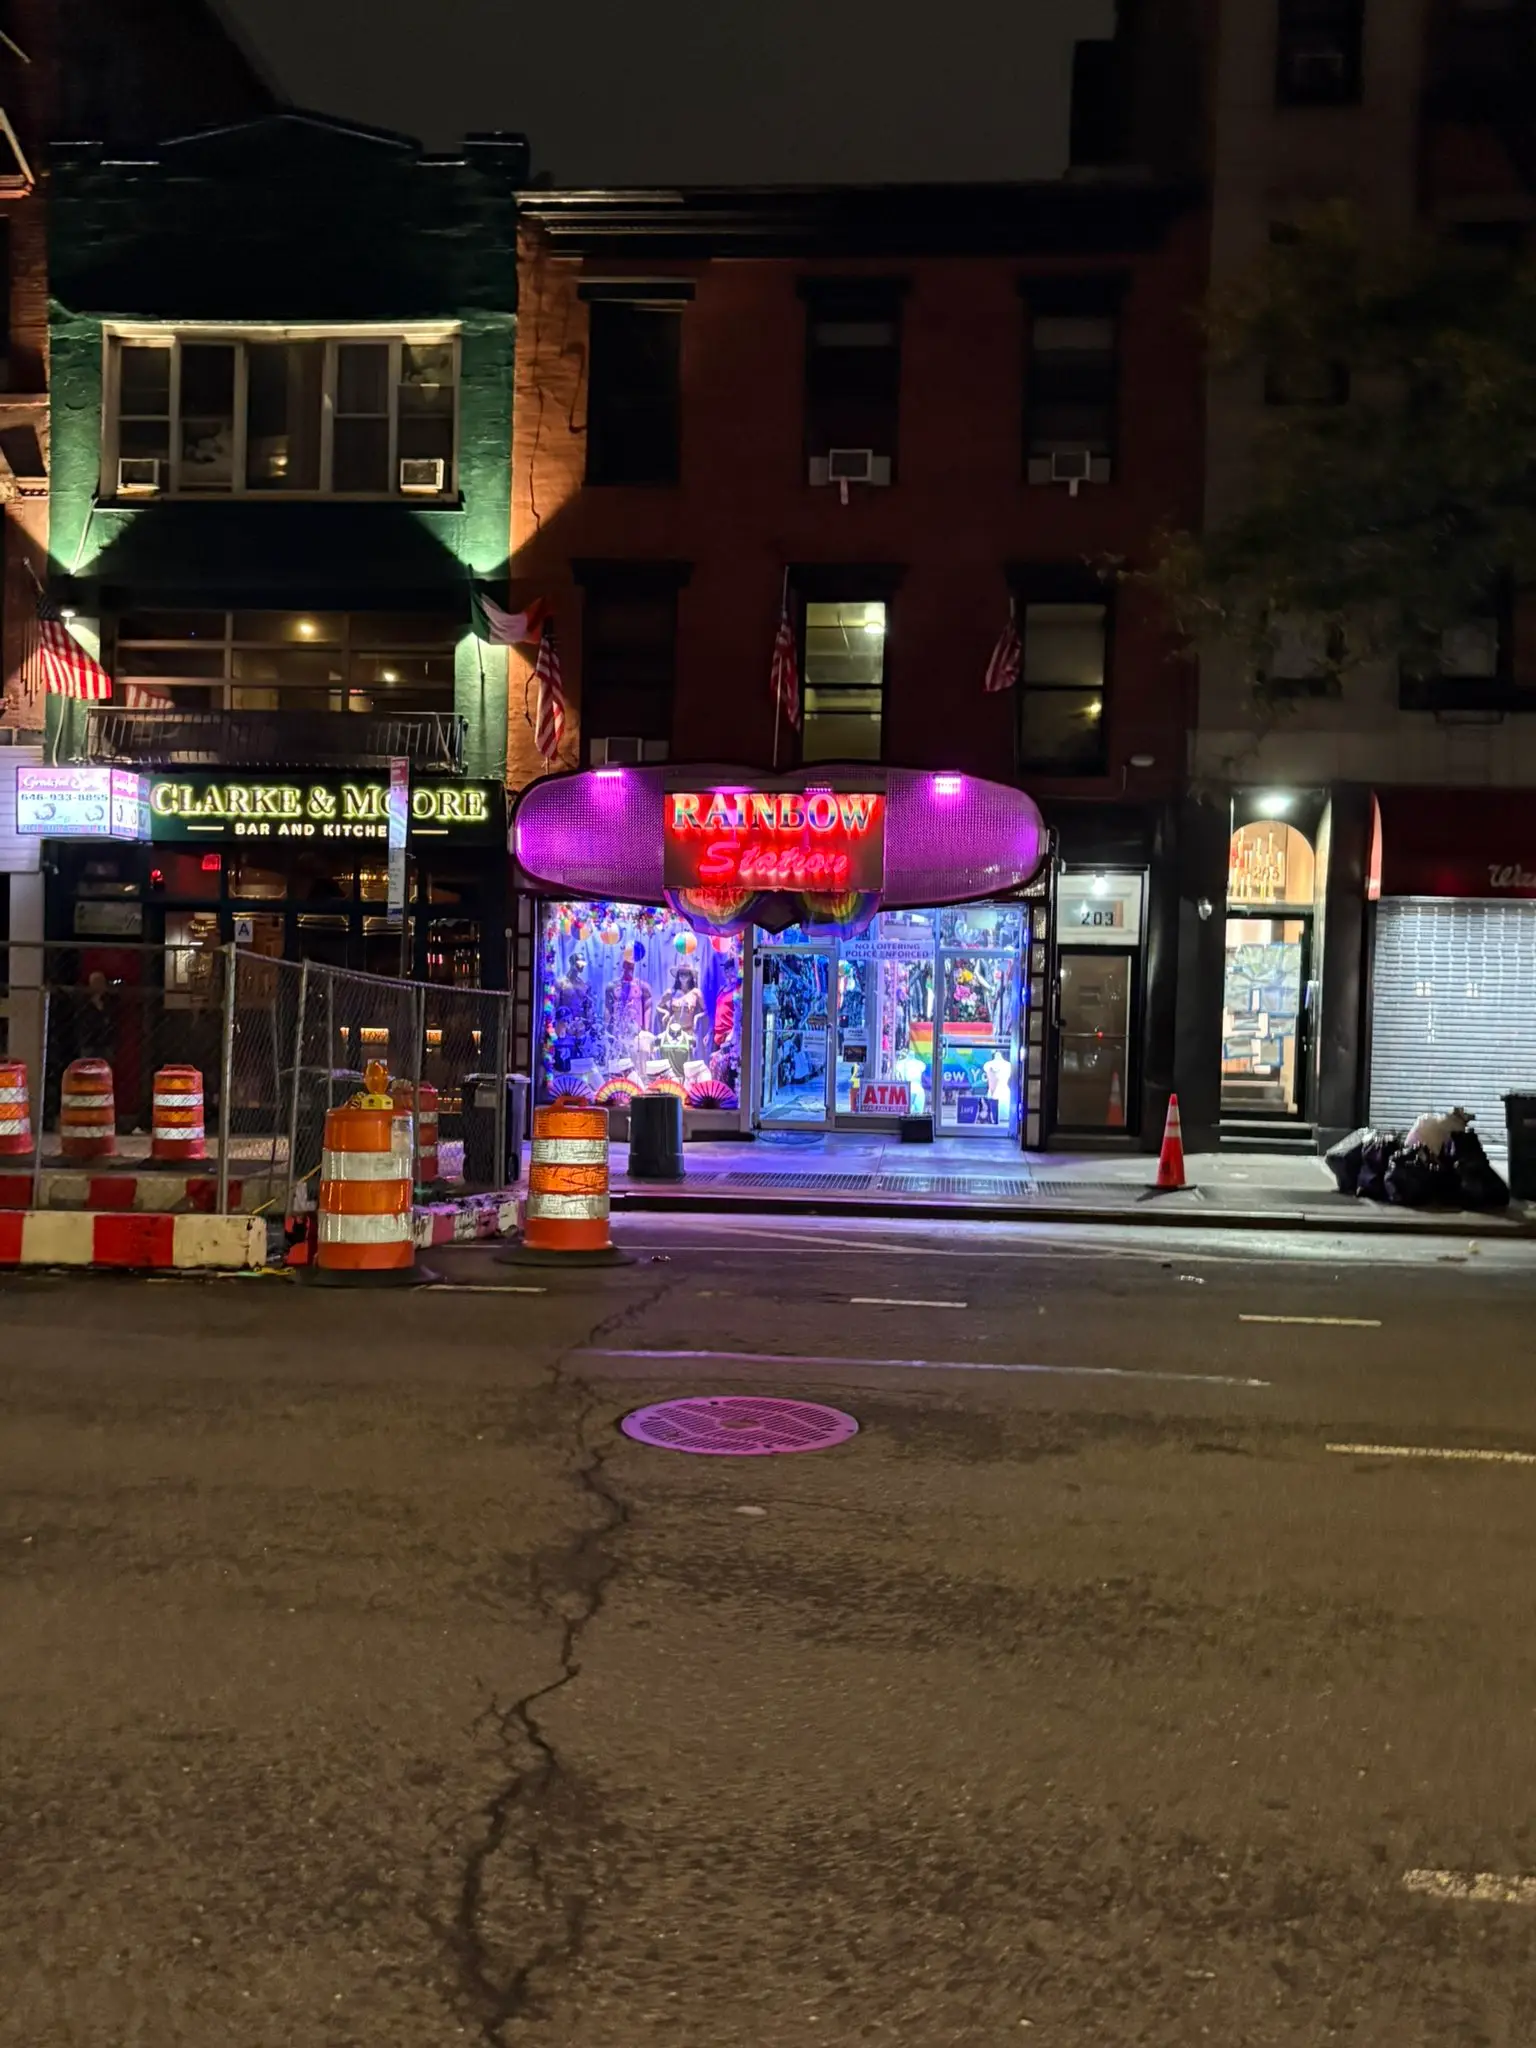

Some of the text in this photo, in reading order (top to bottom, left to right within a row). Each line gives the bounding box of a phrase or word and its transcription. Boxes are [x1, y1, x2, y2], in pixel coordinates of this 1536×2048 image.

[151, 783, 302, 817] CLARKE
[307, 786, 336, 819] &
[672, 793, 877, 832] RAINBOW
[235, 823, 388, 837] BAR AND KITCHE
[700, 841, 847, 874] Station
[1081, 911, 1114, 926] 203
[238, 921, 250, 937] A
[845, 950, 929, 958] POLICE ENFORCED
[862, 1085, 908, 1105] ATM
